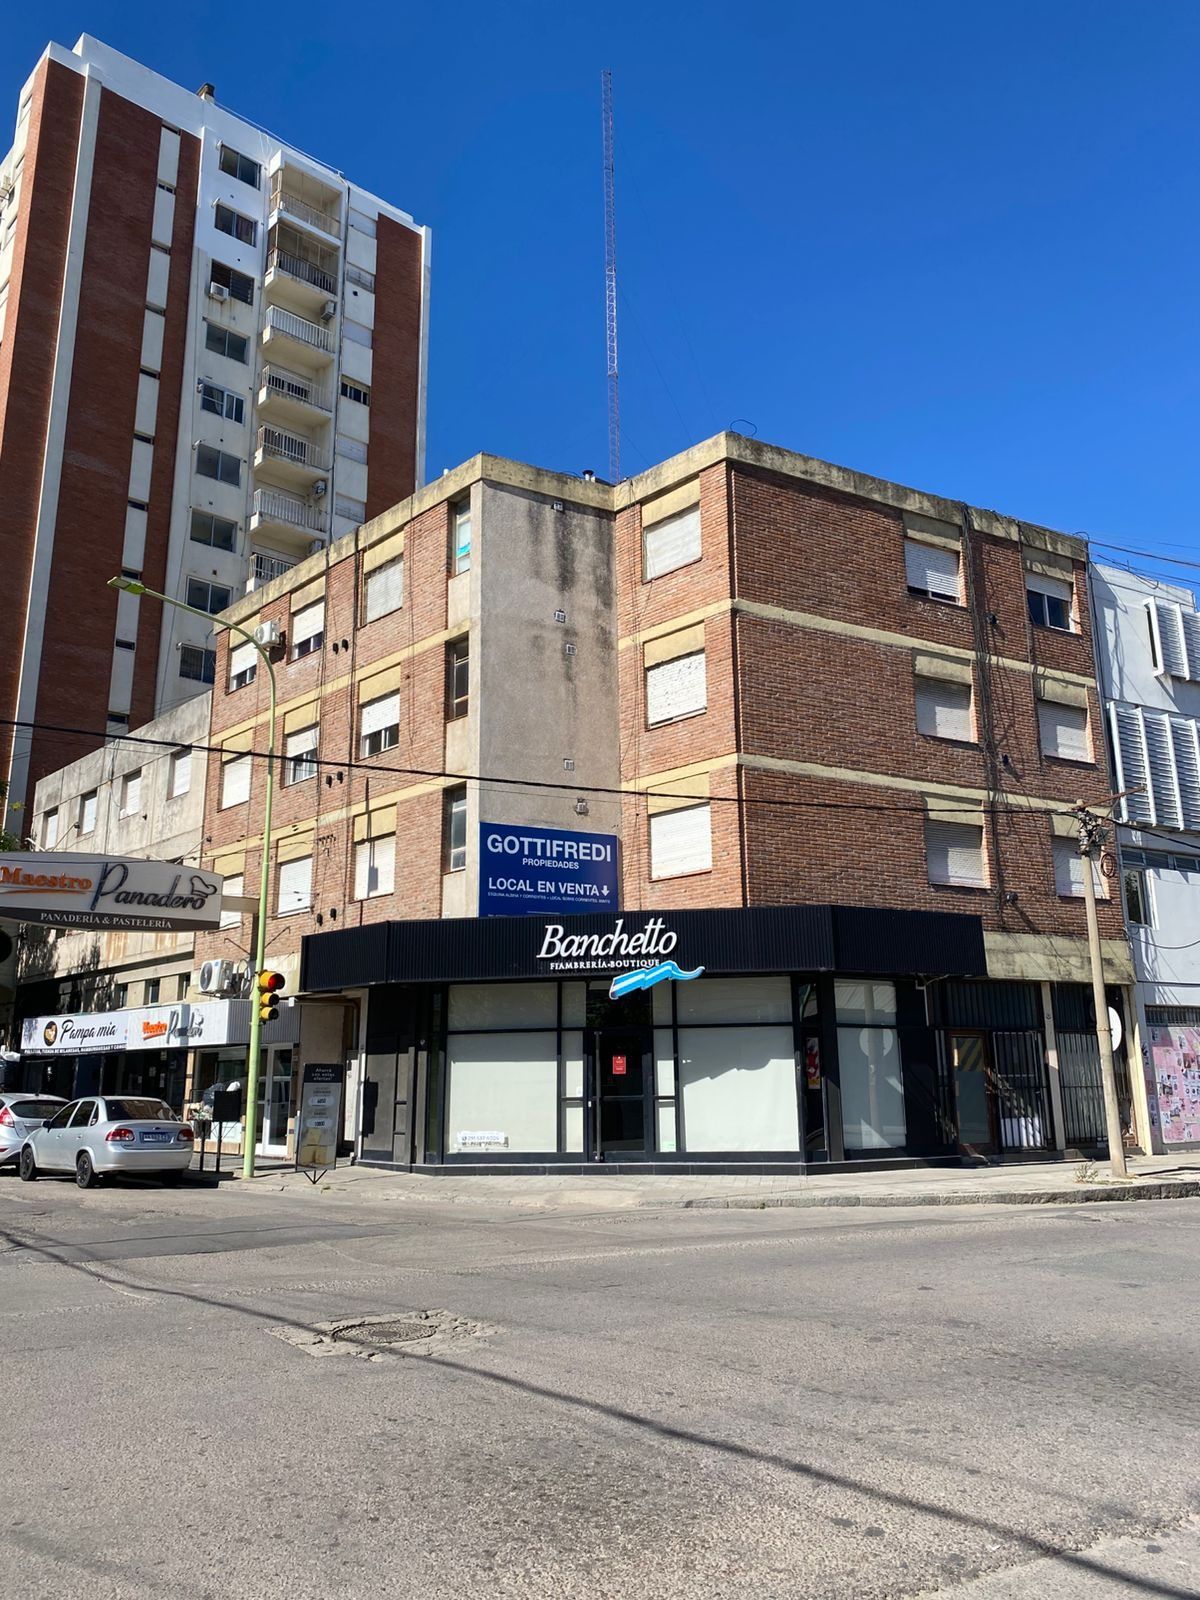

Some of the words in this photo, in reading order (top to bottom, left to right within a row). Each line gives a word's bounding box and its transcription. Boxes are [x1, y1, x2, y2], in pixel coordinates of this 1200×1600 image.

[487, 834, 611, 862] GOTTIFREDI
[522, 858, 579, 869] PROPIEDADES
[0, 866, 94, 890] Maestro
[90, 862, 206, 911] Panadero
[488, 877, 534, 892] LOCAL
[537, 880, 555, 893] EN
[558, 882, 600, 896] VENTA
[40, 912, 100, 924] PANADERÍA
[102, 916, 111, 924] &
[113, 916, 172, 928] PASTELERÍA
[536, 918, 677, 958] Banchetto
[60, 1019, 95, 1045] Pampa
